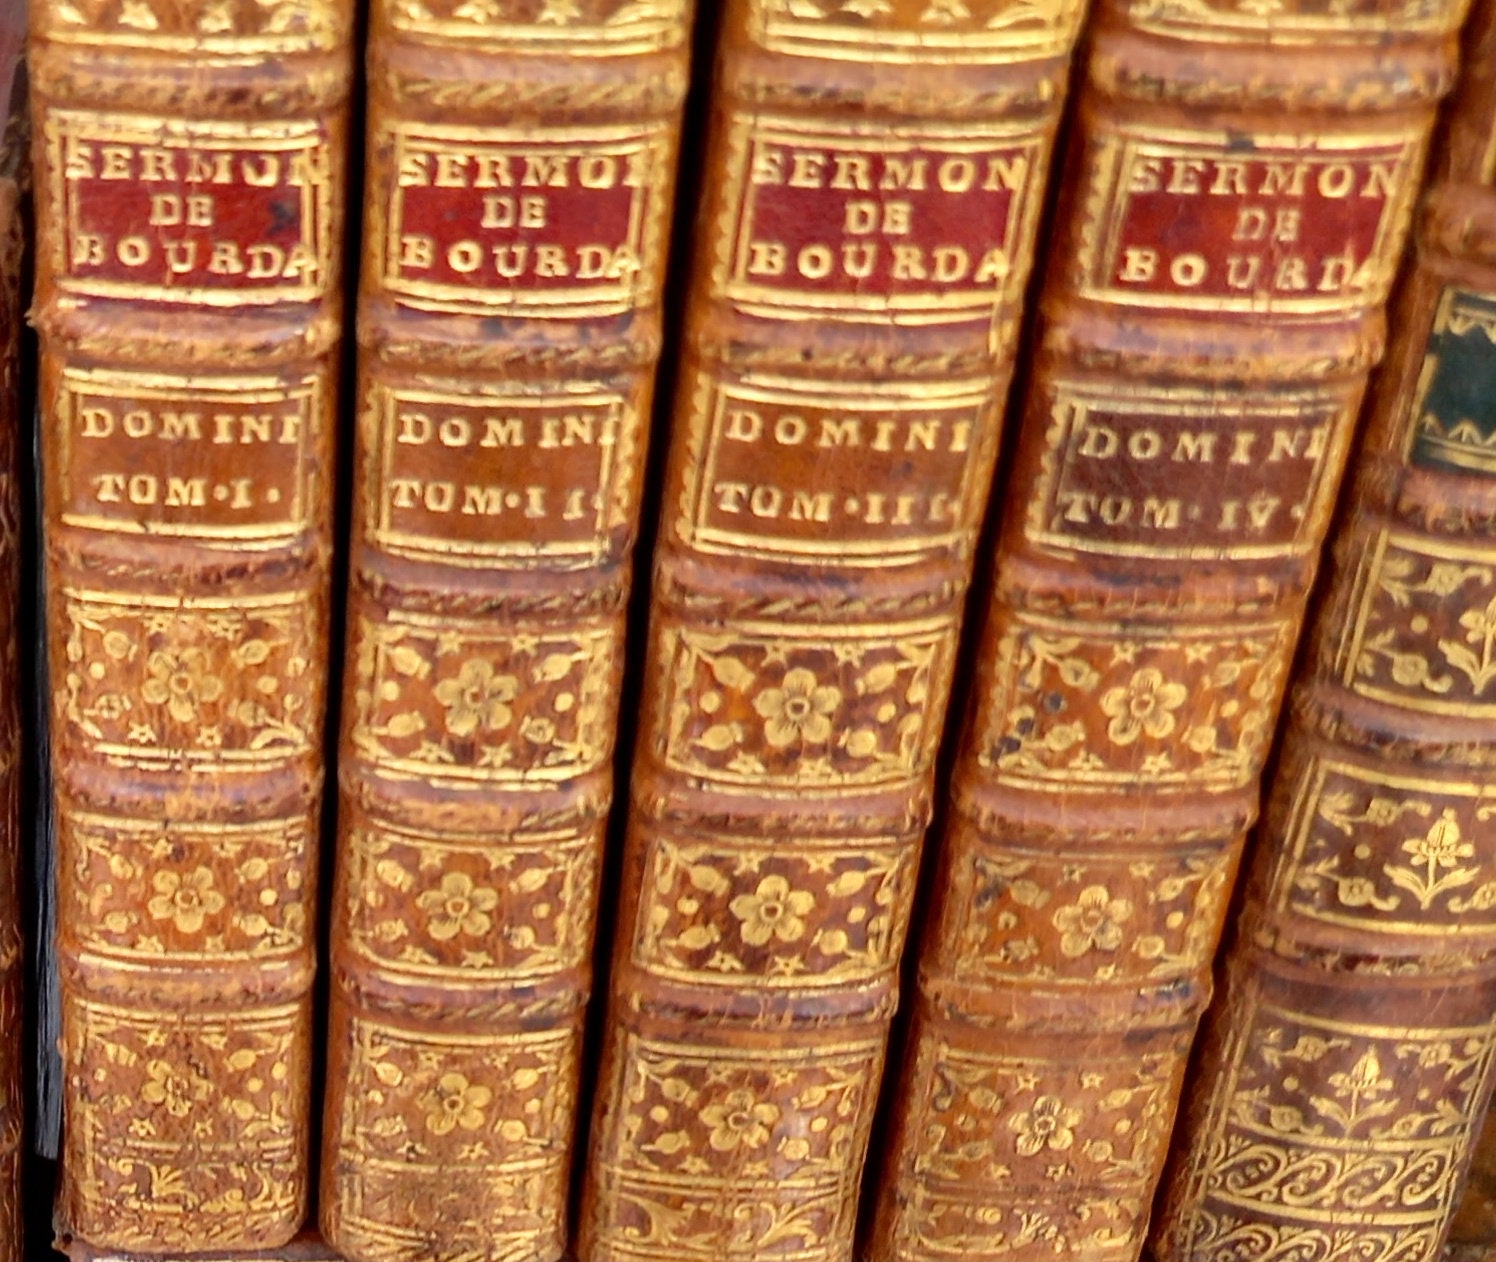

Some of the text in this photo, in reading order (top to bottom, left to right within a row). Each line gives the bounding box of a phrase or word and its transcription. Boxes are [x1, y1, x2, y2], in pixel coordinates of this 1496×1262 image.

[752, 152, 1026, 192] SERMON
[1129, 160, 1397, 197] SERMON
[150, 194, 213, 226] DE
[481, 196, 547, 228] DE
[844, 201, 913, 235] DE
[1232, 208, 1300, 241] DE
[73, 235, 318, 278] BOURDA
[400, 236, 641, 278] BOURDA
[749, 243, 1009, 283] BOURDA
[81, 408, 302, 443] DOMINI
[397, 414, 618, 448] DOMINI
[725, 411, 973, 451] DOMINI
[1078, 426, 1328, 463] DOMINI
